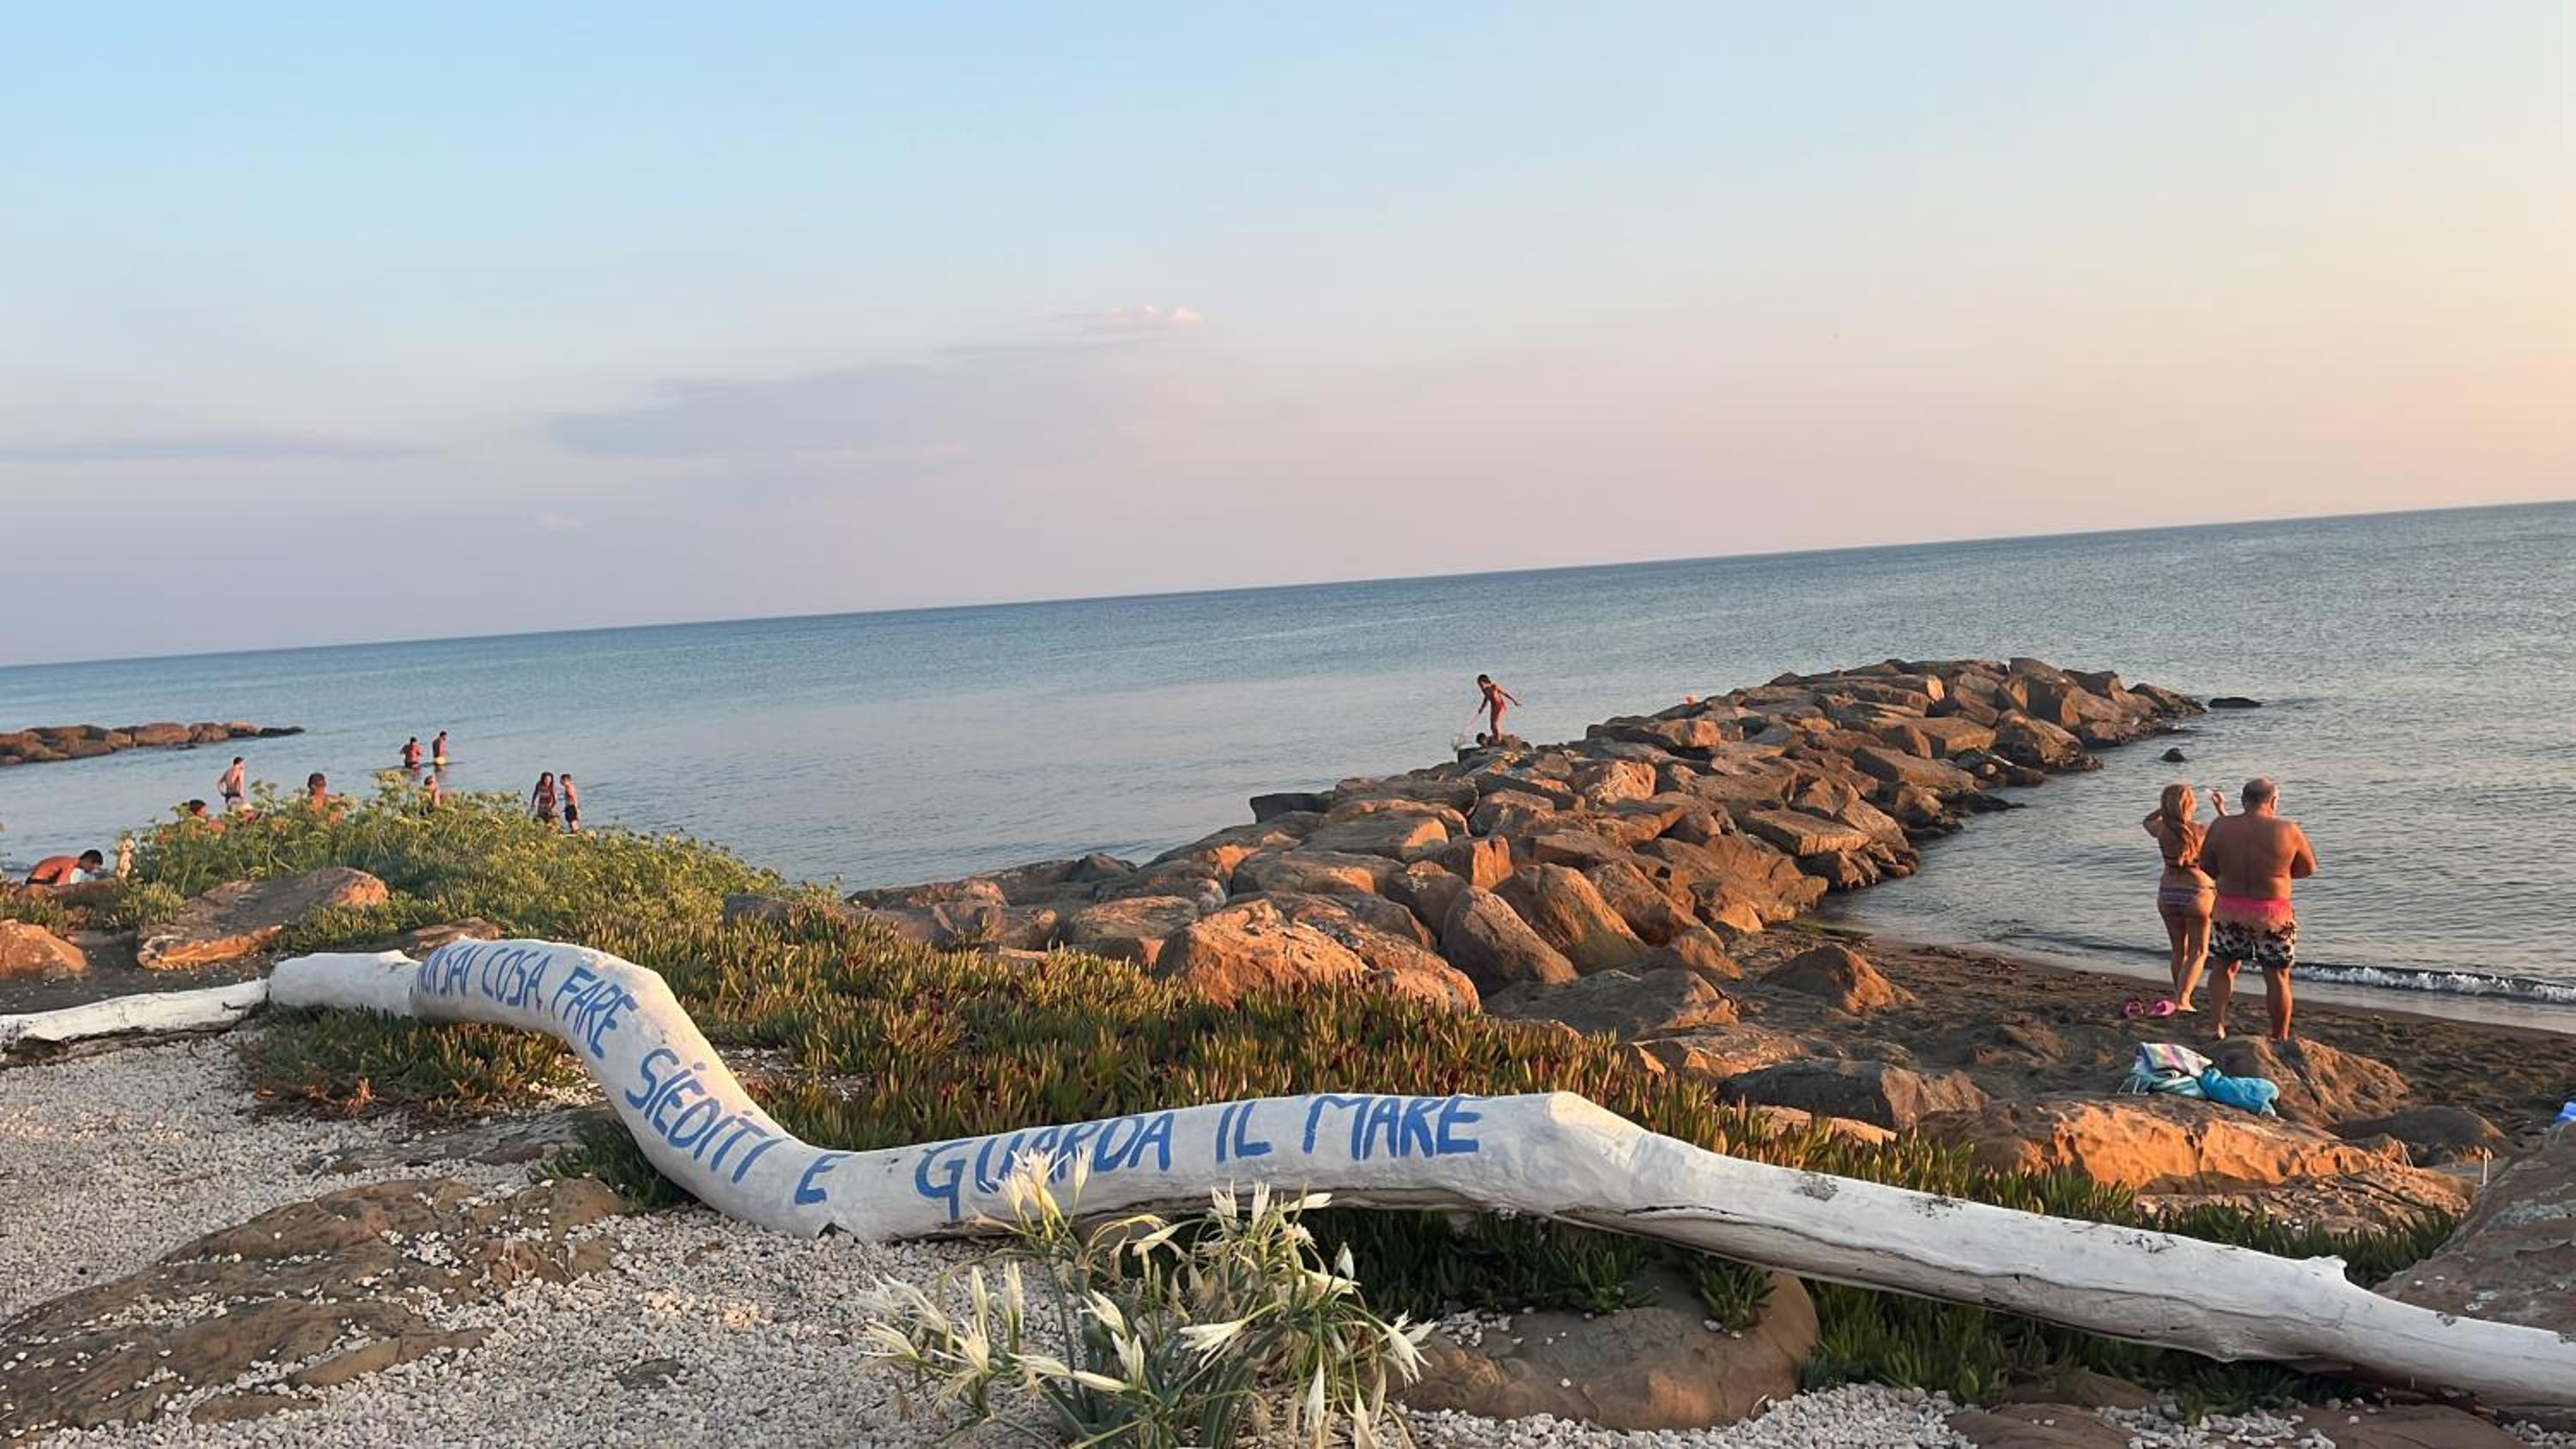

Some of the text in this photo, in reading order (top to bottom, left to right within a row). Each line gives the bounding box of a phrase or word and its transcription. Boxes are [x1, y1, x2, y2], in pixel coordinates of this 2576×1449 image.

[482, 947, 553, 1011] COSA
[550, 966, 640, 1059] FARE
[794, 1152, 853, 1204] E
[1216, 1100, 1273, 1163] IL
[1303, 1094, 1492, 1161] MARE
